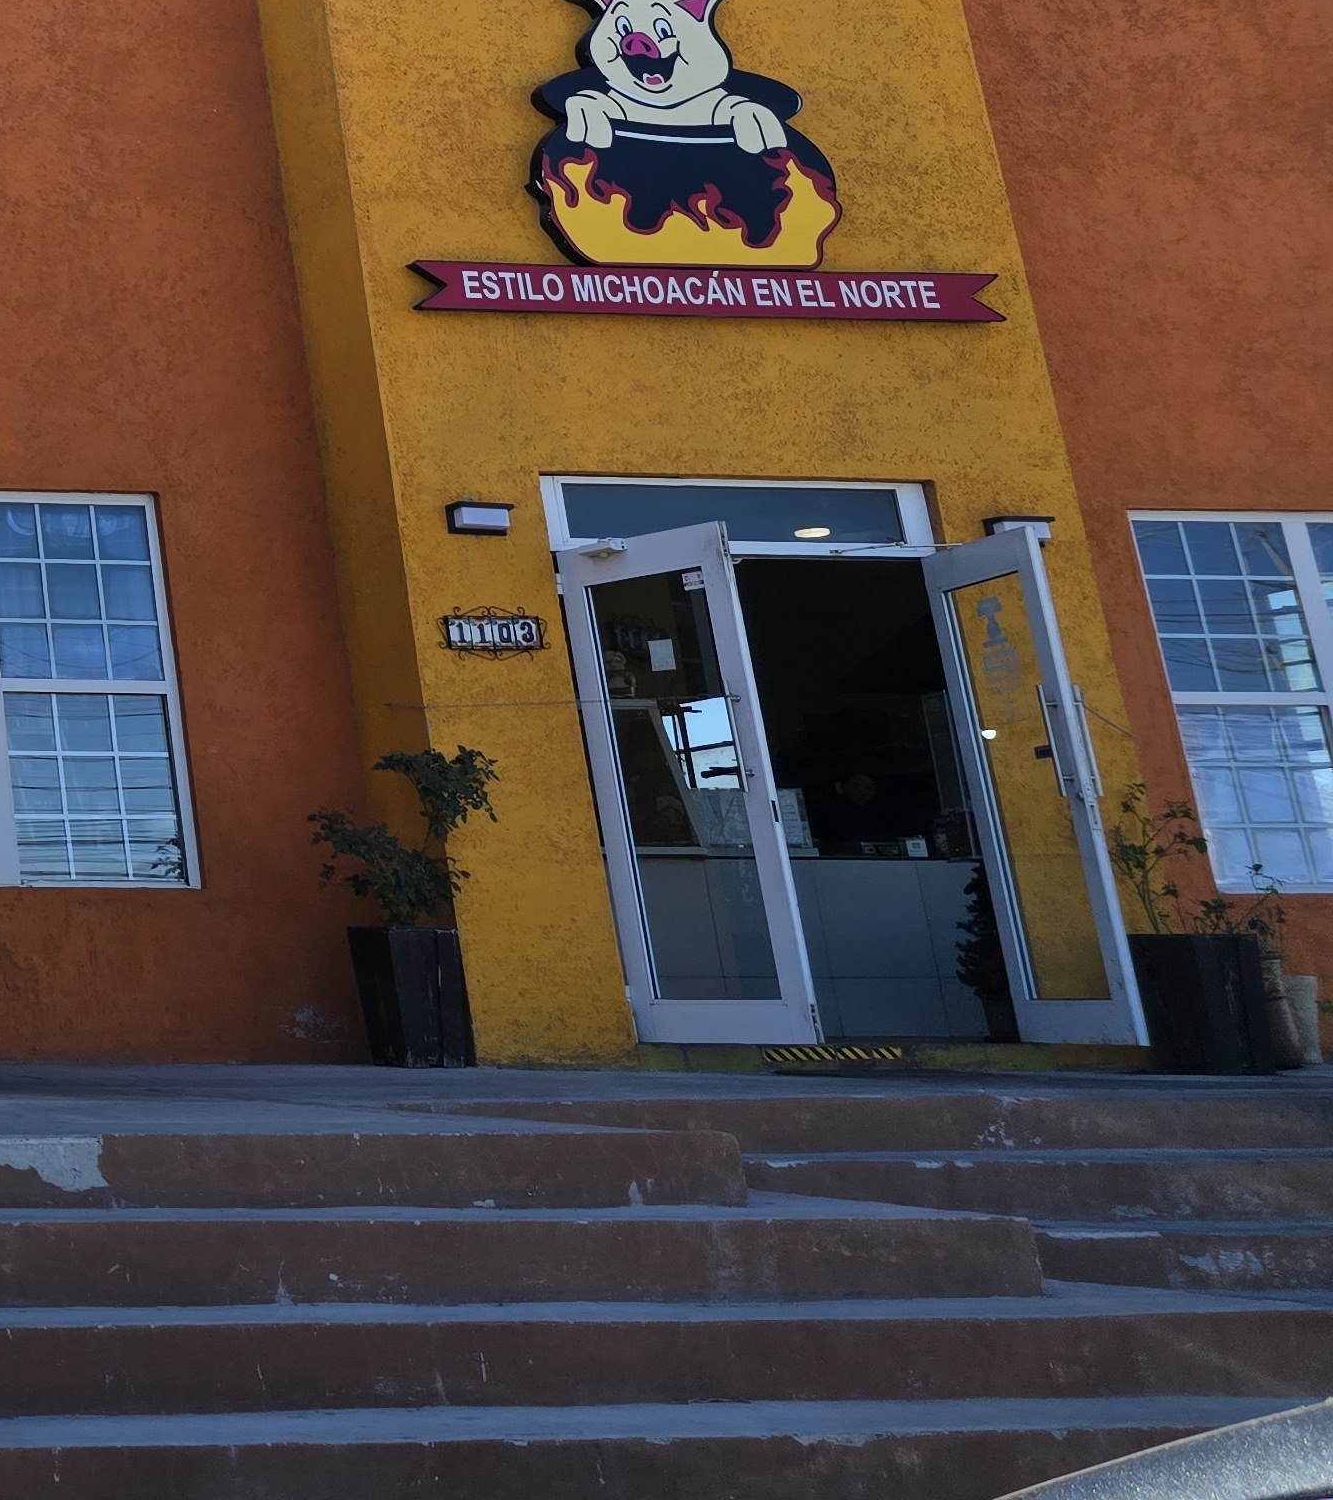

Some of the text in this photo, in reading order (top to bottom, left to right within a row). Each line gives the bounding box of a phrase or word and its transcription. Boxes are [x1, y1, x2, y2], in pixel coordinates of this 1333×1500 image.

[461, 270, 941, 309] ESTILO MICHOACÁN EN EL NORTE
[455, 621, 535, 644] 1103
